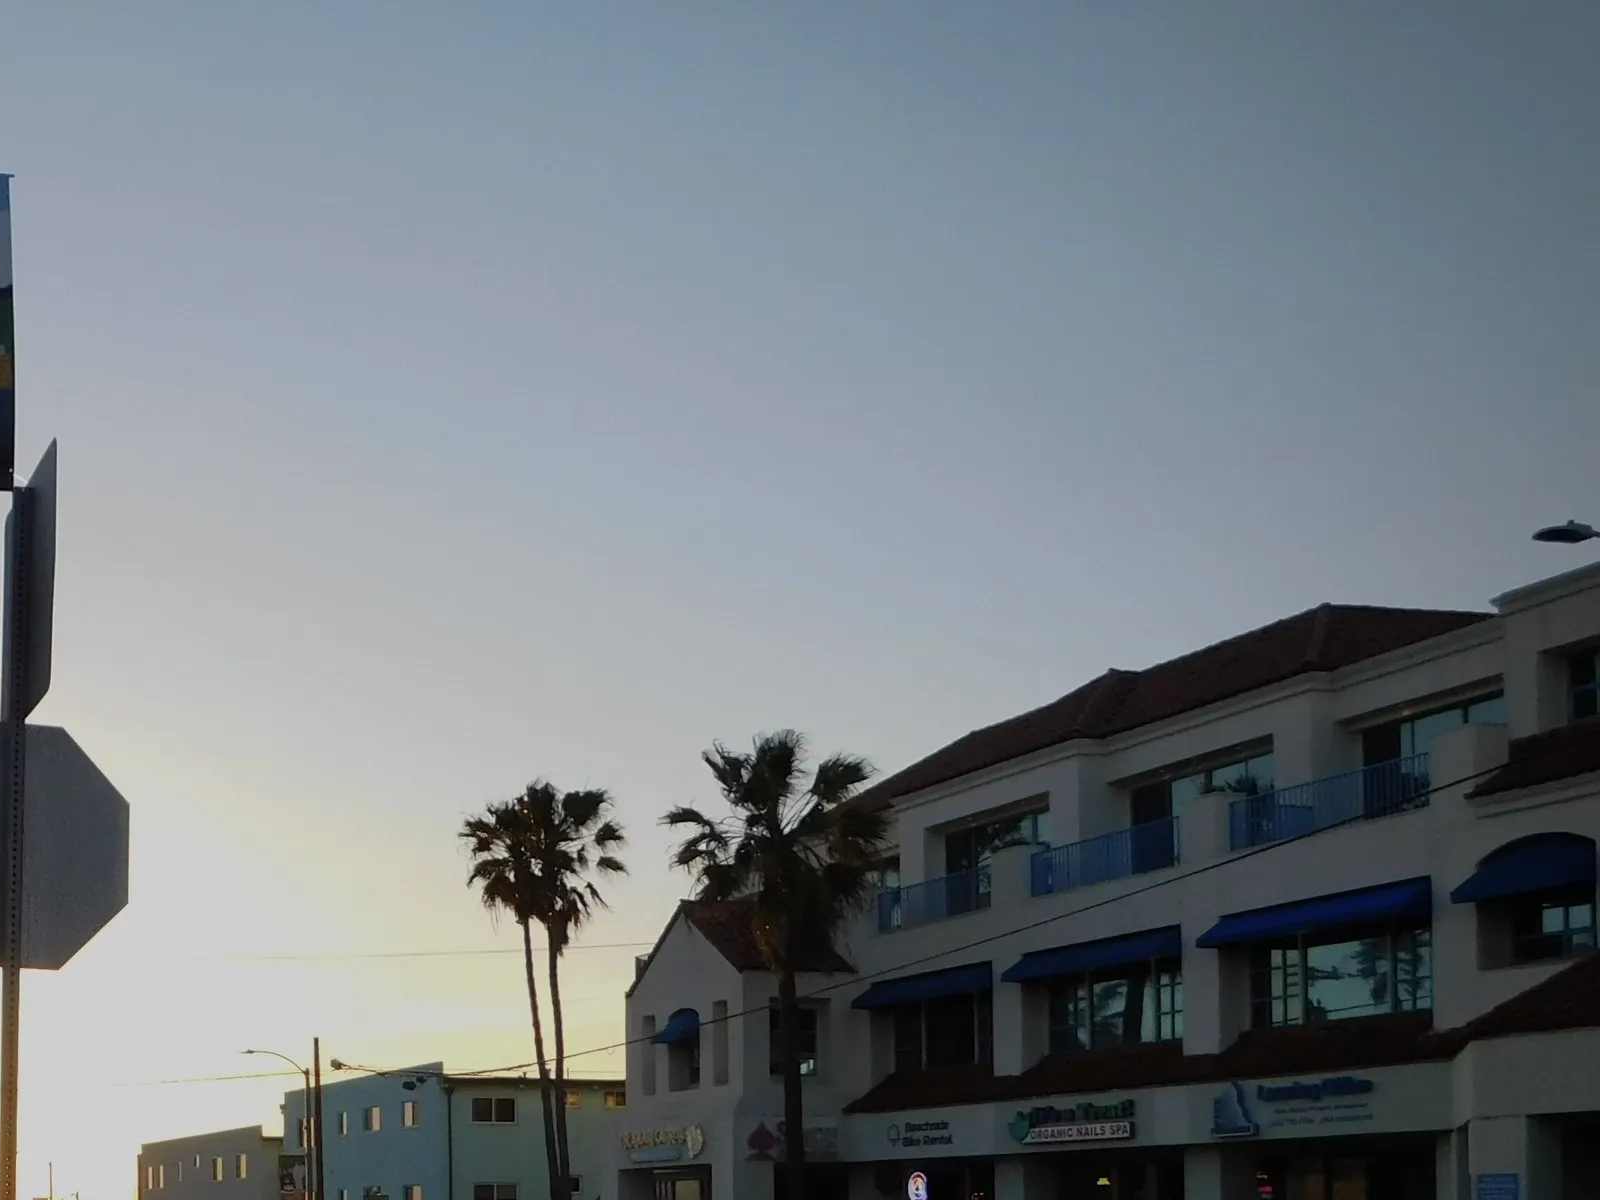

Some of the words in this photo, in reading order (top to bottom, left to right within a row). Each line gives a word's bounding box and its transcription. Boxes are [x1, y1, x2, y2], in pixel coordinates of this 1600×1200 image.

[1030, 1127, 1073, 1140] ORGANIC
[1076, 1125, 1106, 1137] NAILS
[1110, 1123, 1129, 1135] SPA
